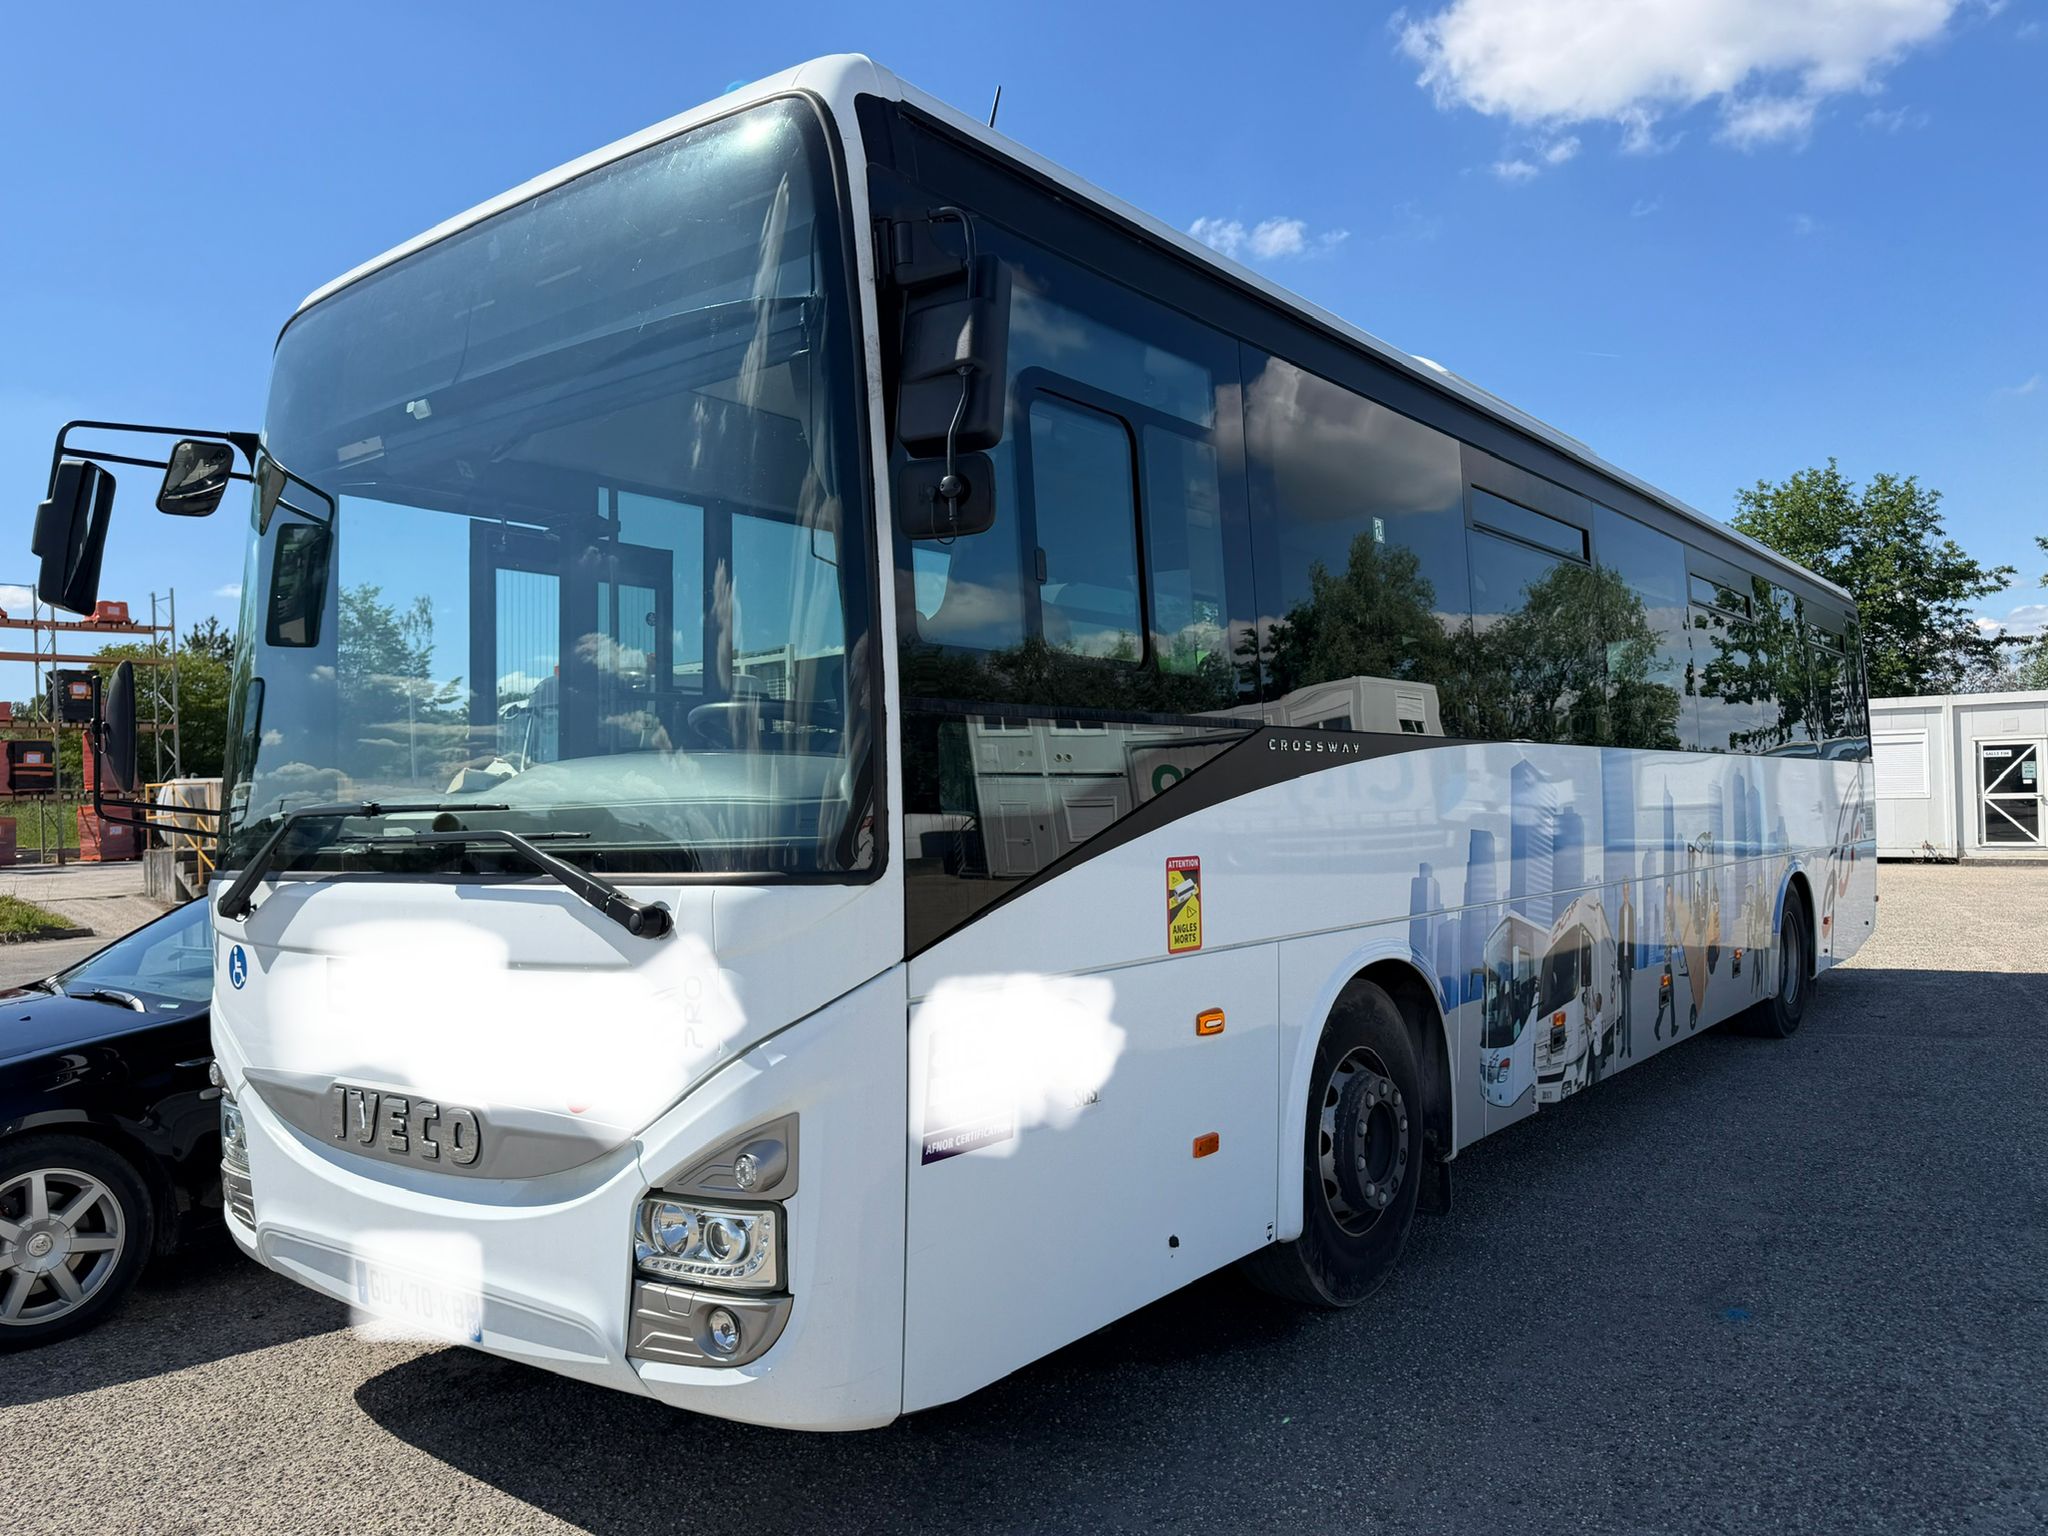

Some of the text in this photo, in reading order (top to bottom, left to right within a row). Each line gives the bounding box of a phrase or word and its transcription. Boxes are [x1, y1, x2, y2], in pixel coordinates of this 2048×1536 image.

[1268, 738, 1360, 753] CROSSWAY
[1168, 859, 1199, 869] ATTENTION
[1172, 922, 1197, 935] ANGLES
[1174, 933, 1197, 945] MORTS
[334, 1085, 482, 1165] IVECO
[926, 1137, 954, 1155] AFNOR
